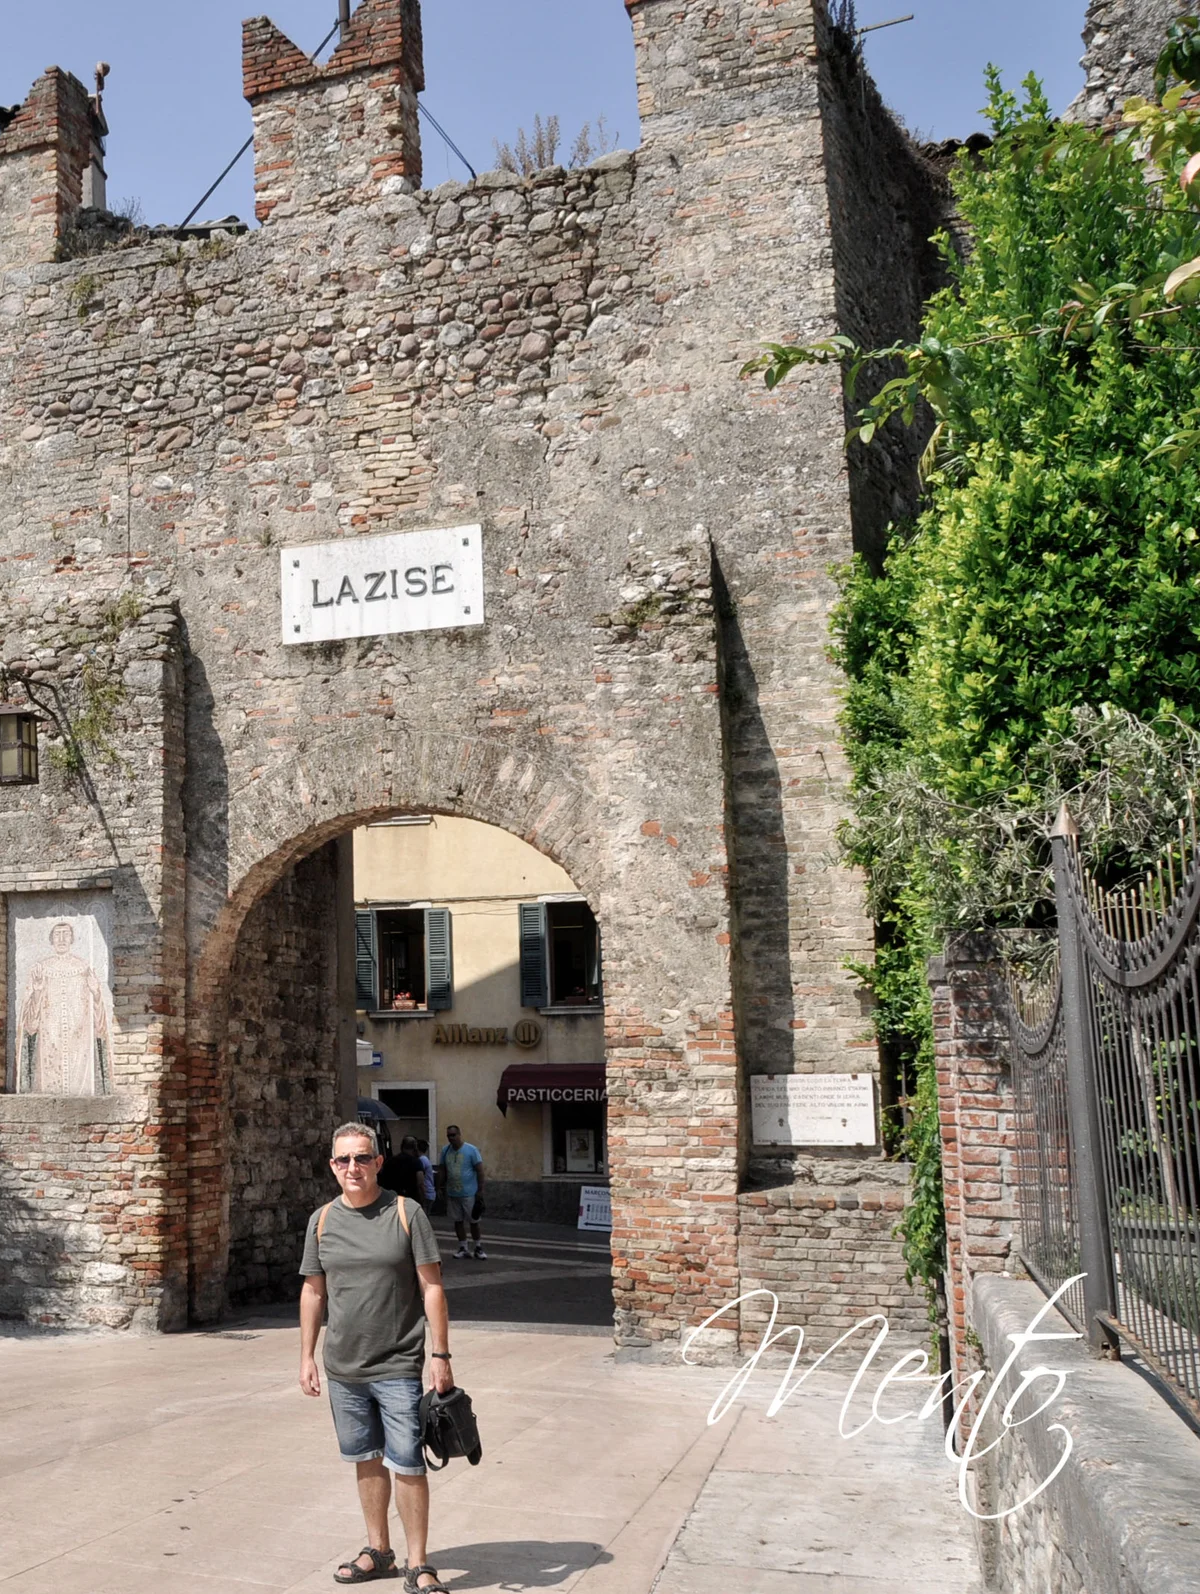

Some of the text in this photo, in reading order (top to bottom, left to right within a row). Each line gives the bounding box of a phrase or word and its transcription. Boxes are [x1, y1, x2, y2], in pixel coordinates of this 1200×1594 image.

[311, 564, 455, 608] LAZISE
[433, 1023, 509, 1044] Allianz
[507, 1088, 609, 1102] PASTICCERIA
